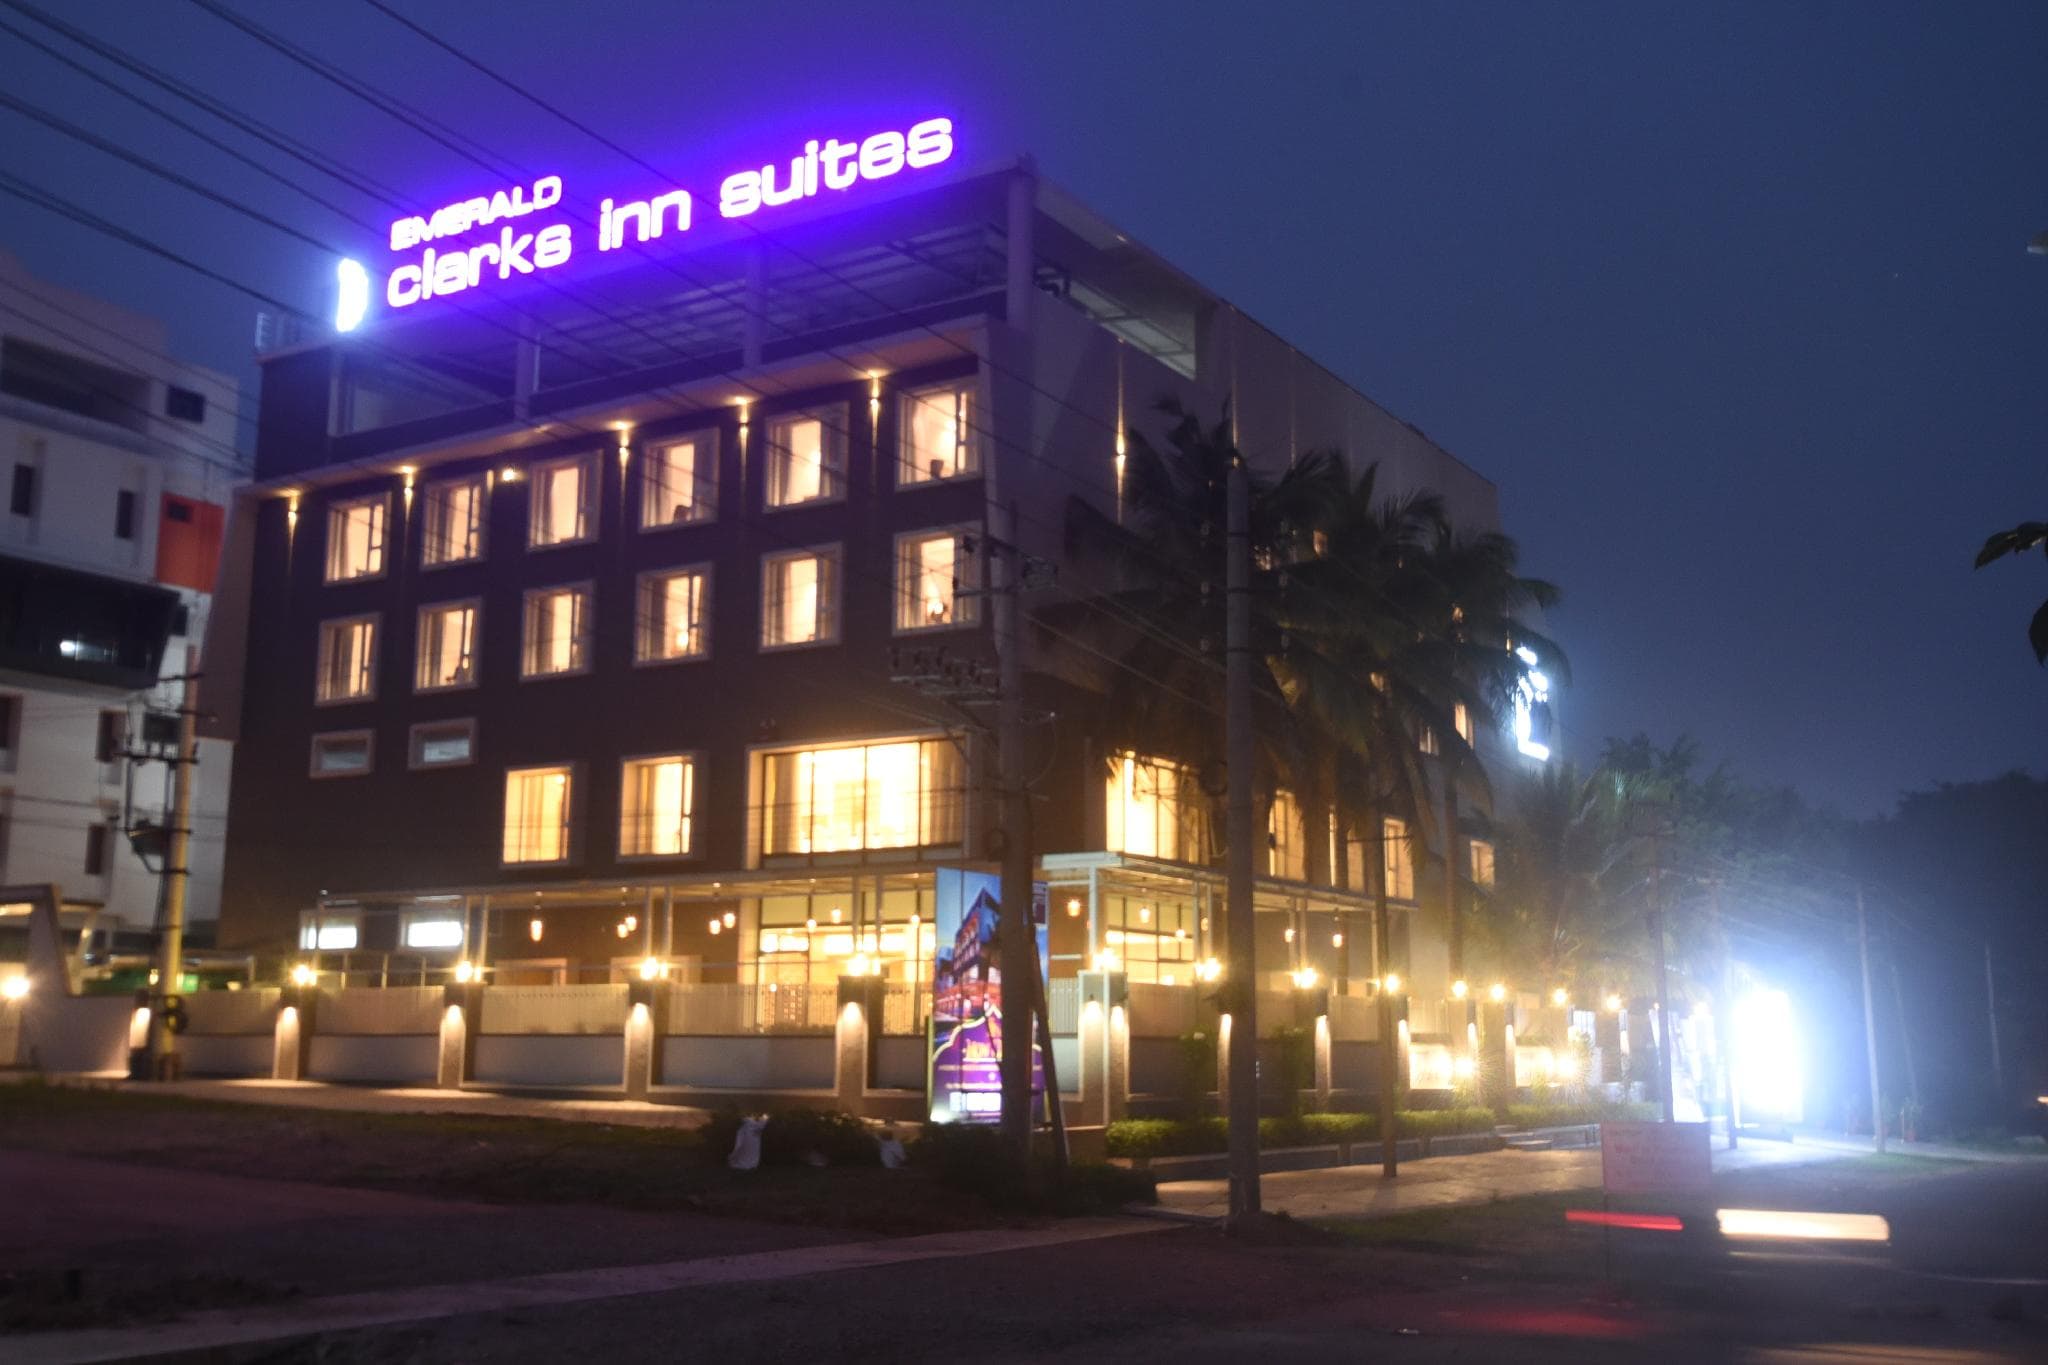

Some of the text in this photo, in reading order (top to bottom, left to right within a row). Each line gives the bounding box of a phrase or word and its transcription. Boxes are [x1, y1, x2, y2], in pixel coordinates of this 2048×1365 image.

[387, 118, 953, 307] clarks inn suites
[390, 176, 562, 251] EMERALD
